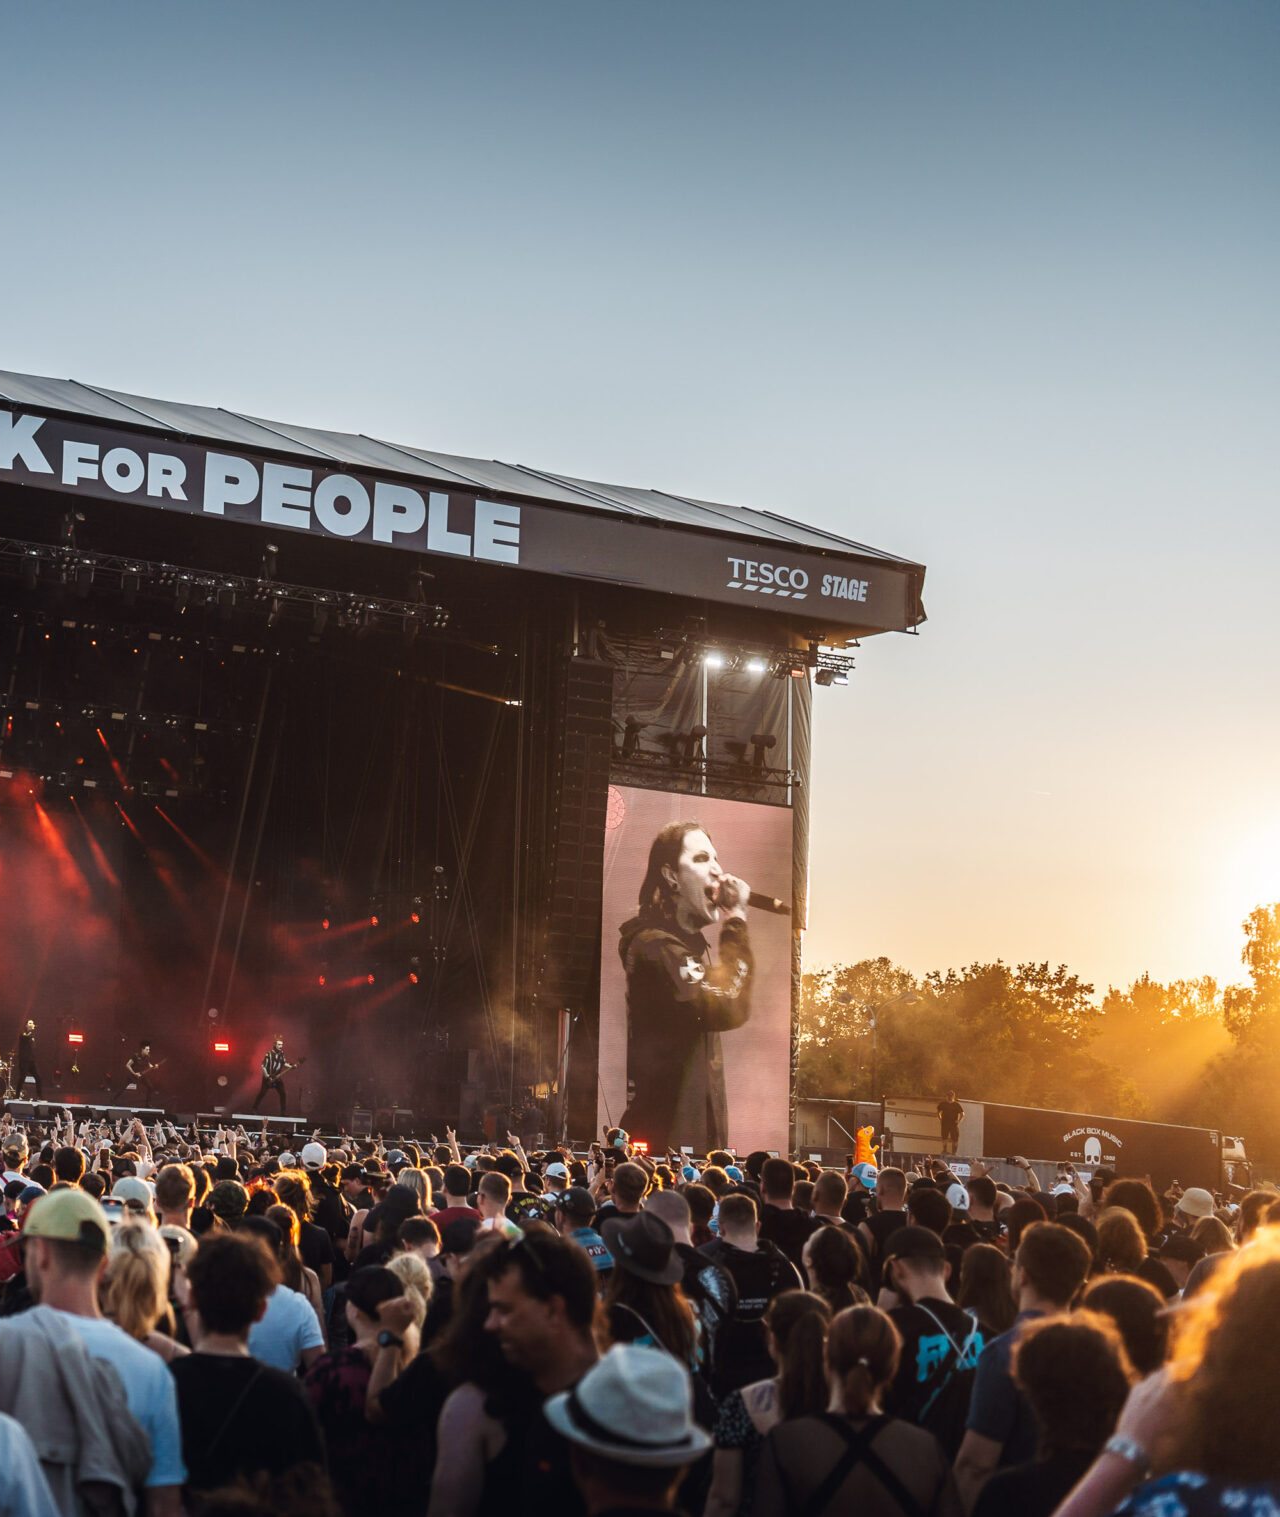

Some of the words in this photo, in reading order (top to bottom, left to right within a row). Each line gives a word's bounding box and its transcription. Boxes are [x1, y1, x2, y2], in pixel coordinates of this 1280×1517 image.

[61, 439, 188, 501] FOR
[203, 451, 521, 564] PEOPLE
[727, 557, 809, 590] TESCO
[820, 574, 868, 602] STAGE
[1063, 1128, 1086, 1142] BLACK
[1086, 1127, 1101, 1136] BOX
[1101, 1130, 1123, 1148] MUSIC
